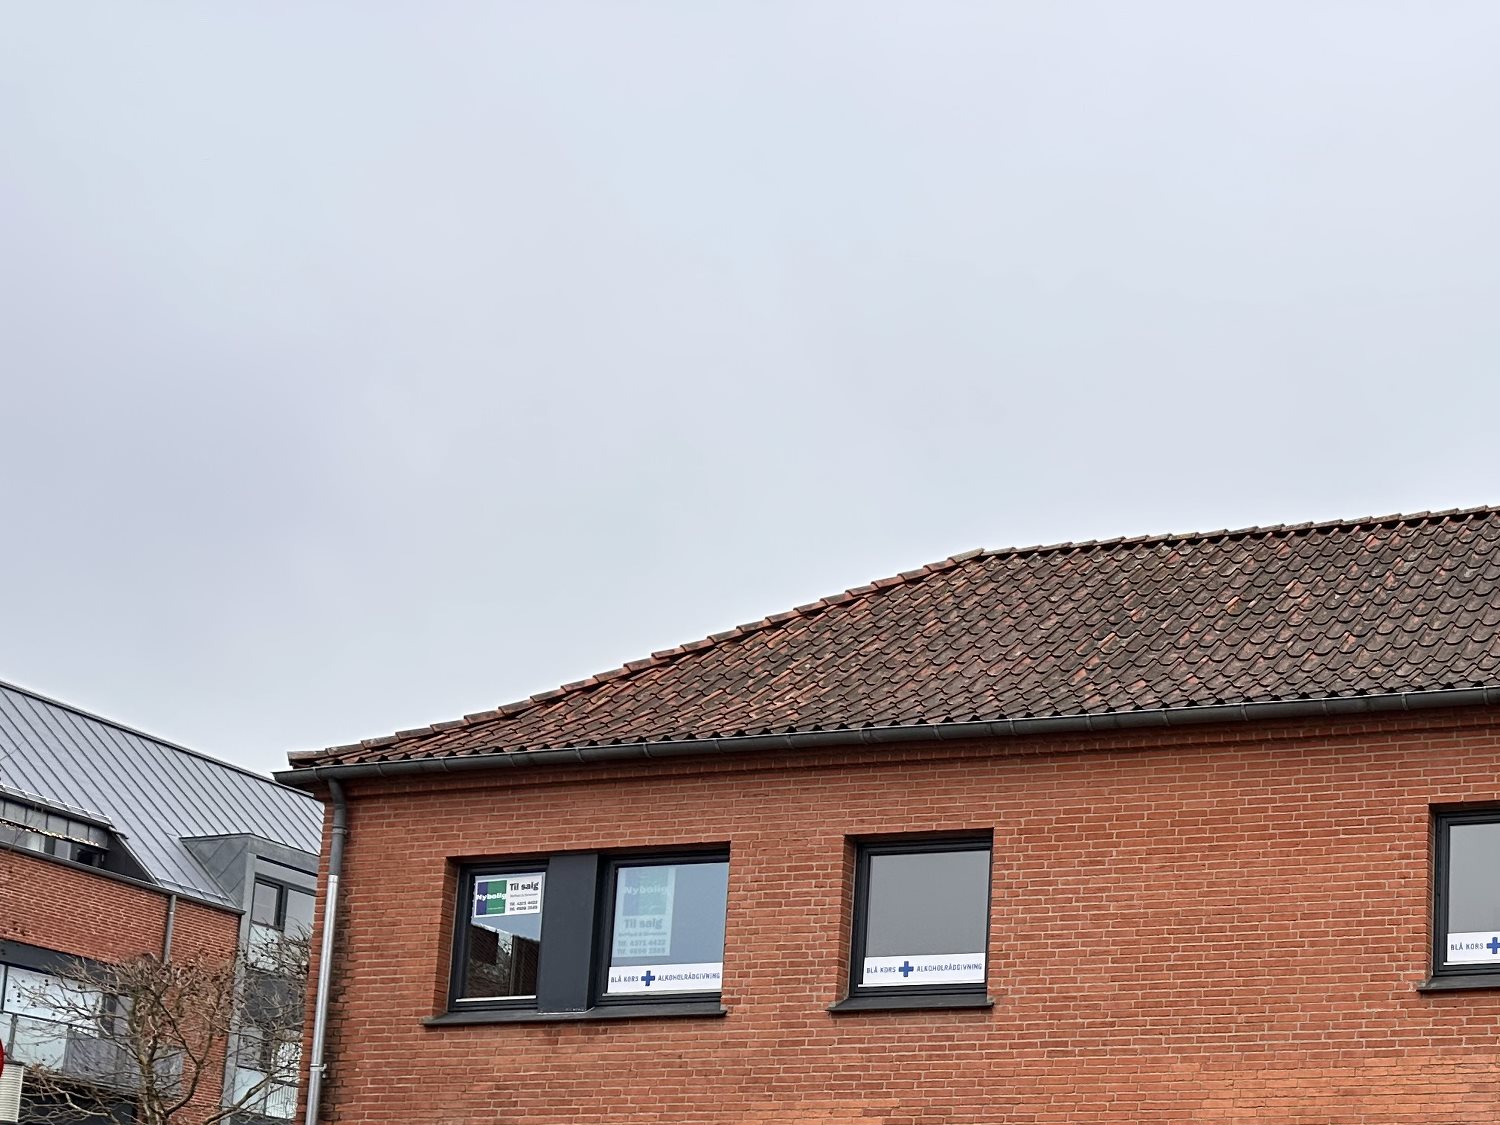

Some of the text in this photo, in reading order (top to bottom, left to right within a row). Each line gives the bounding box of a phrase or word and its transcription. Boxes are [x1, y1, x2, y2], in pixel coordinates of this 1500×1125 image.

[521, 882, 539, 890] salg
[624, 886, 667, 895] Nybolig
[476, 892, 507, 901] Nybolig
[624, 918, 663, 929] Til salg
[1451, 942, 1463, 951] BLÅ
[866, 965, 878, 973] BLÅ
